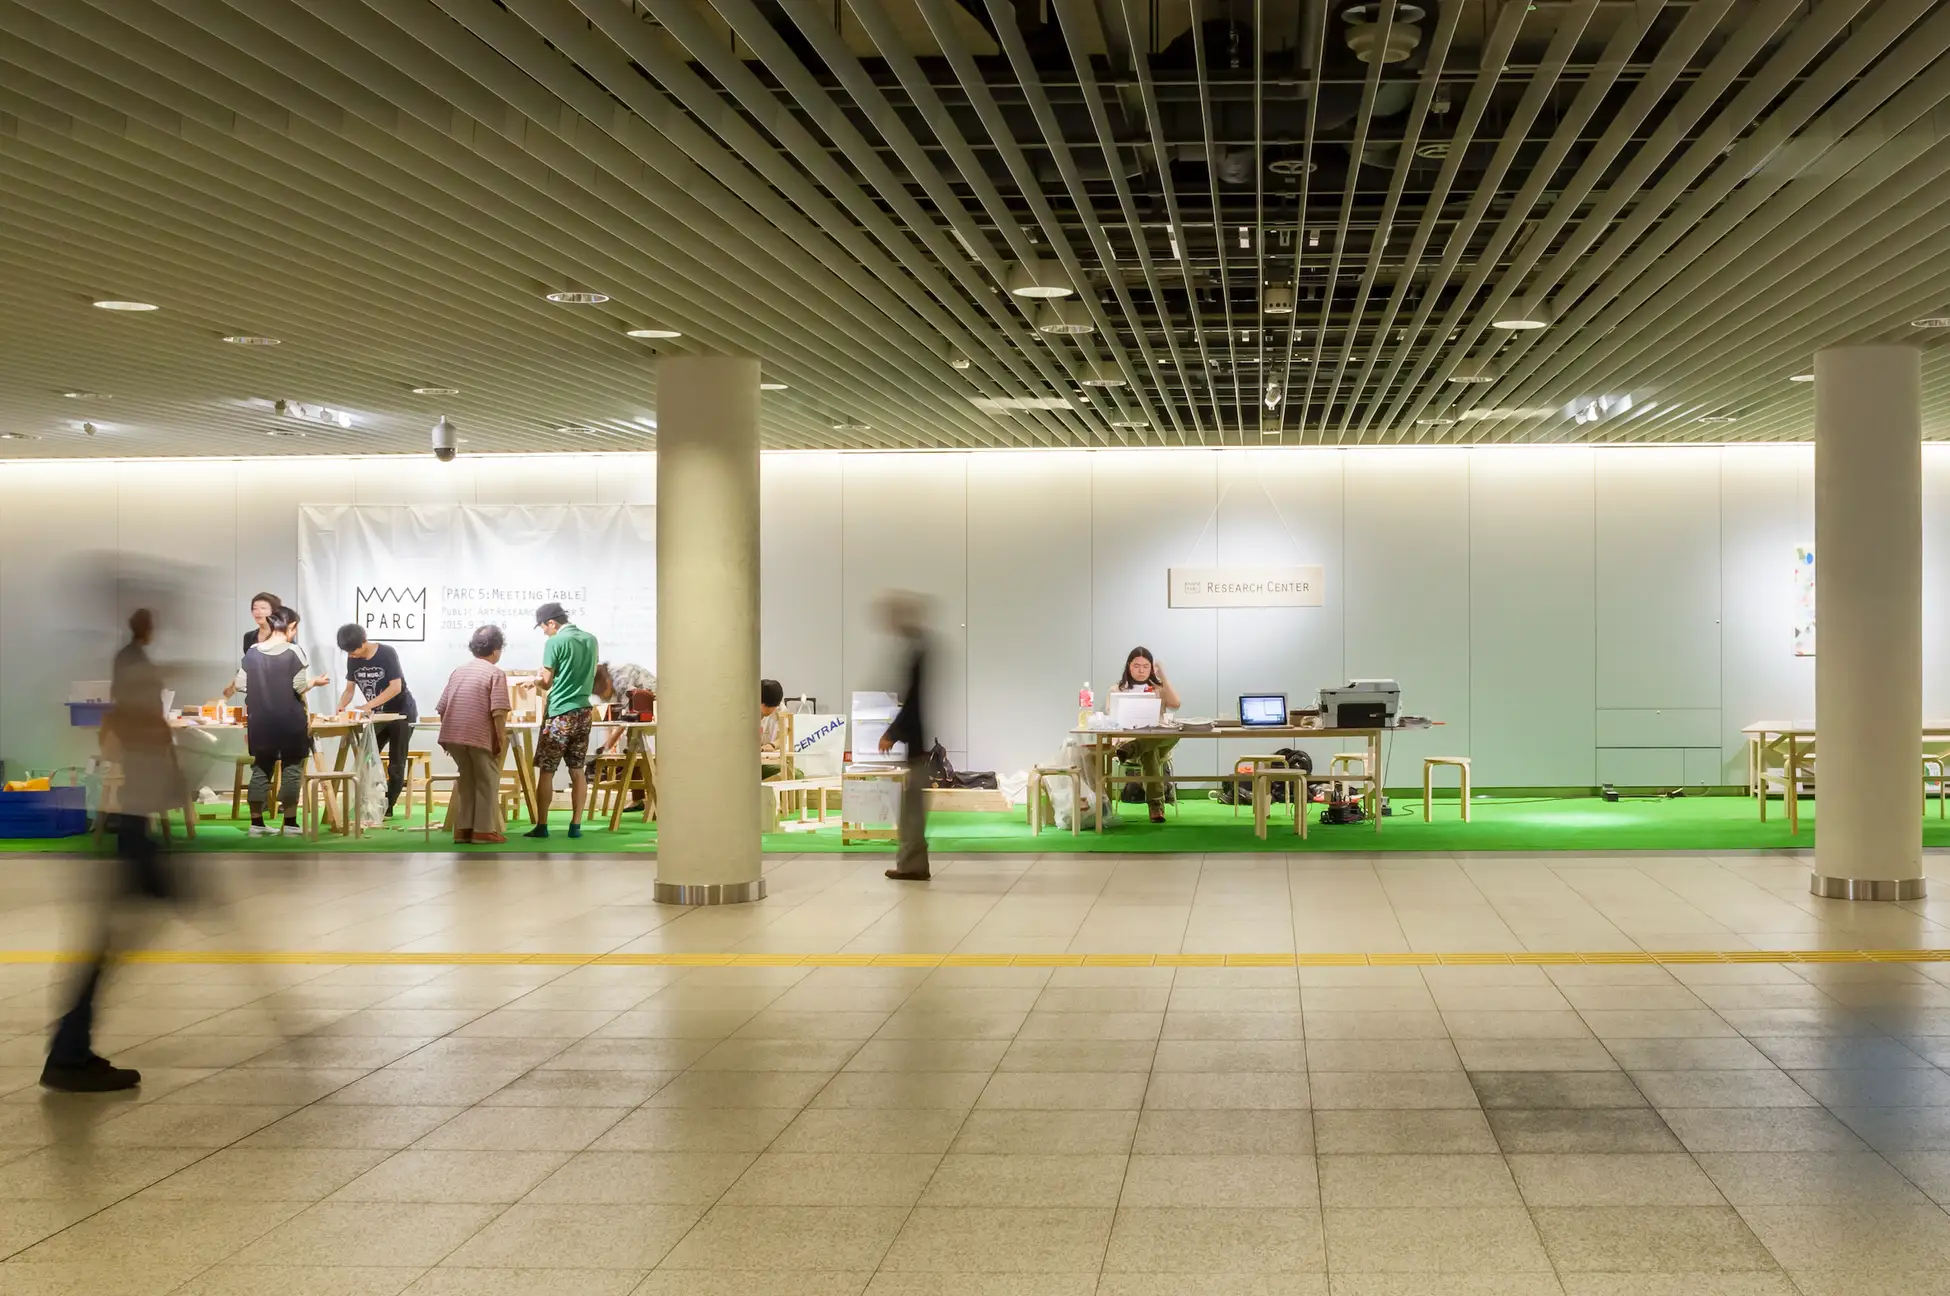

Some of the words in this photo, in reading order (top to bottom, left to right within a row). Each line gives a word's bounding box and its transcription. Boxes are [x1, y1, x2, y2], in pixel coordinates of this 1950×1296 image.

[1207, 581, 1263, 594] RESEARCH
[1267, 580, 1310, 593] CENTER
[366, 612, 416, 630] PARC
[794, 717, 845, 753] CENTRAL
